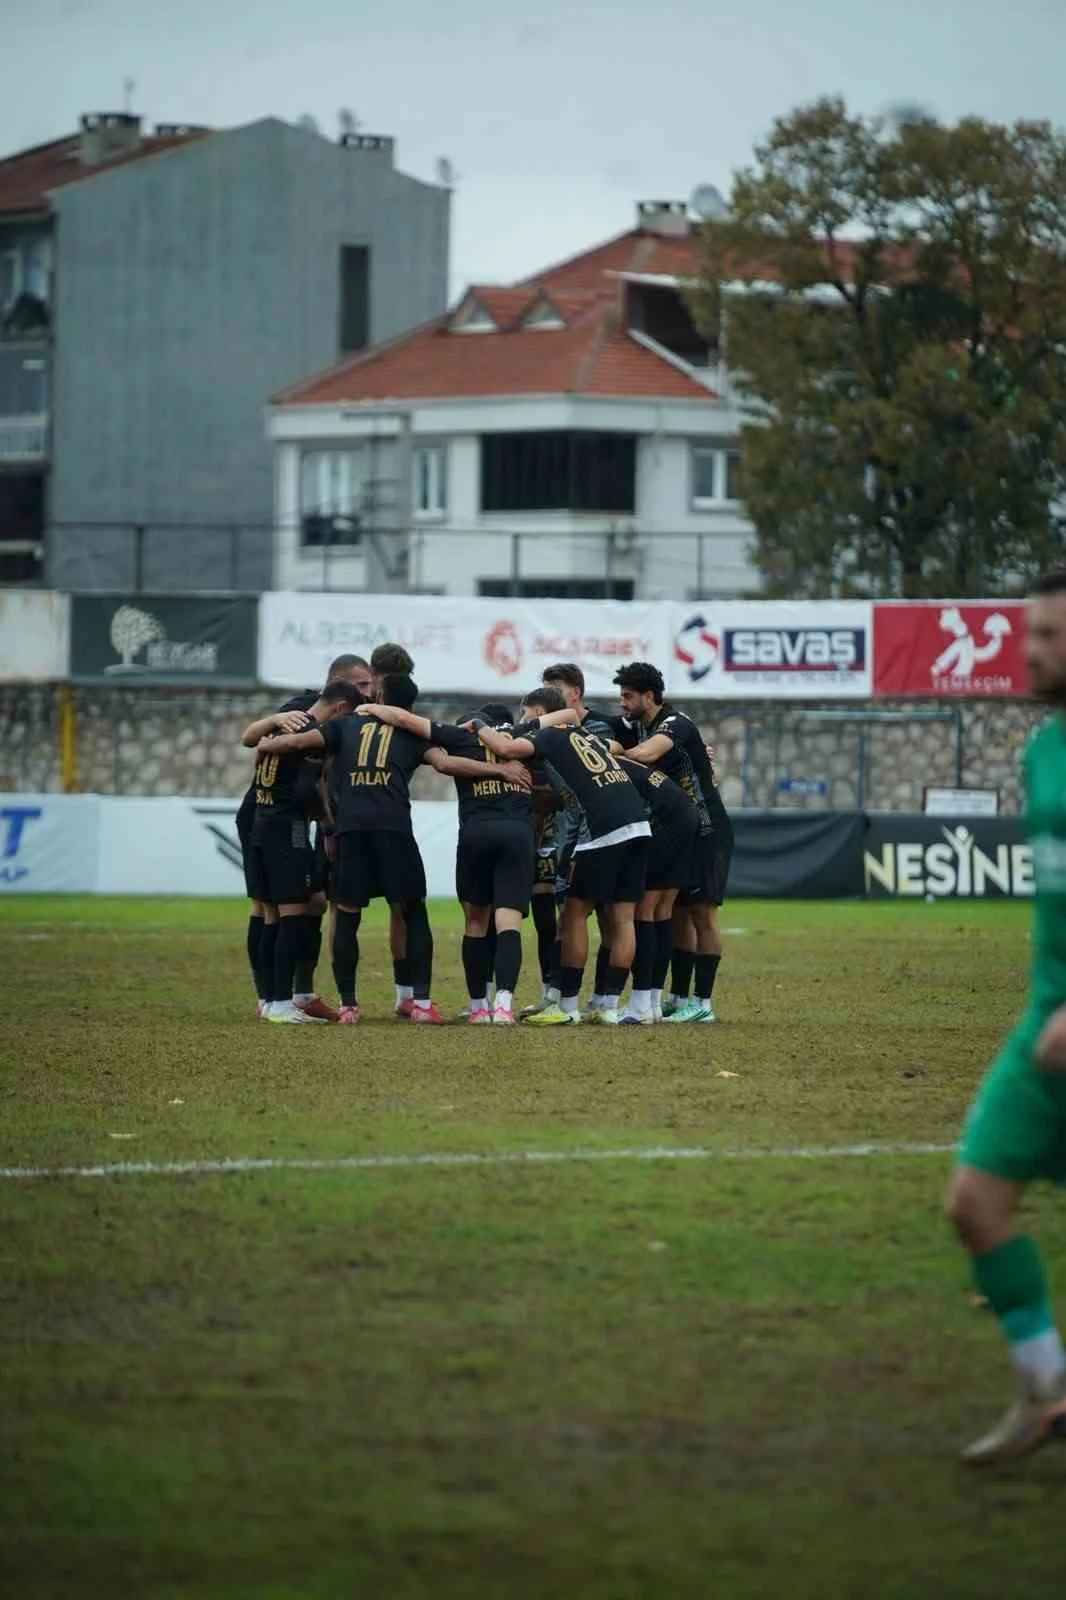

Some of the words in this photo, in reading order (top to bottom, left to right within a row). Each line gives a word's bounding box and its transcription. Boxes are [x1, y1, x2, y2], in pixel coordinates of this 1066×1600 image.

[358, 721, 395, 769] 11
[350, 771, 393, 787] TALAY
[472, 779, 501, 797] MERT
